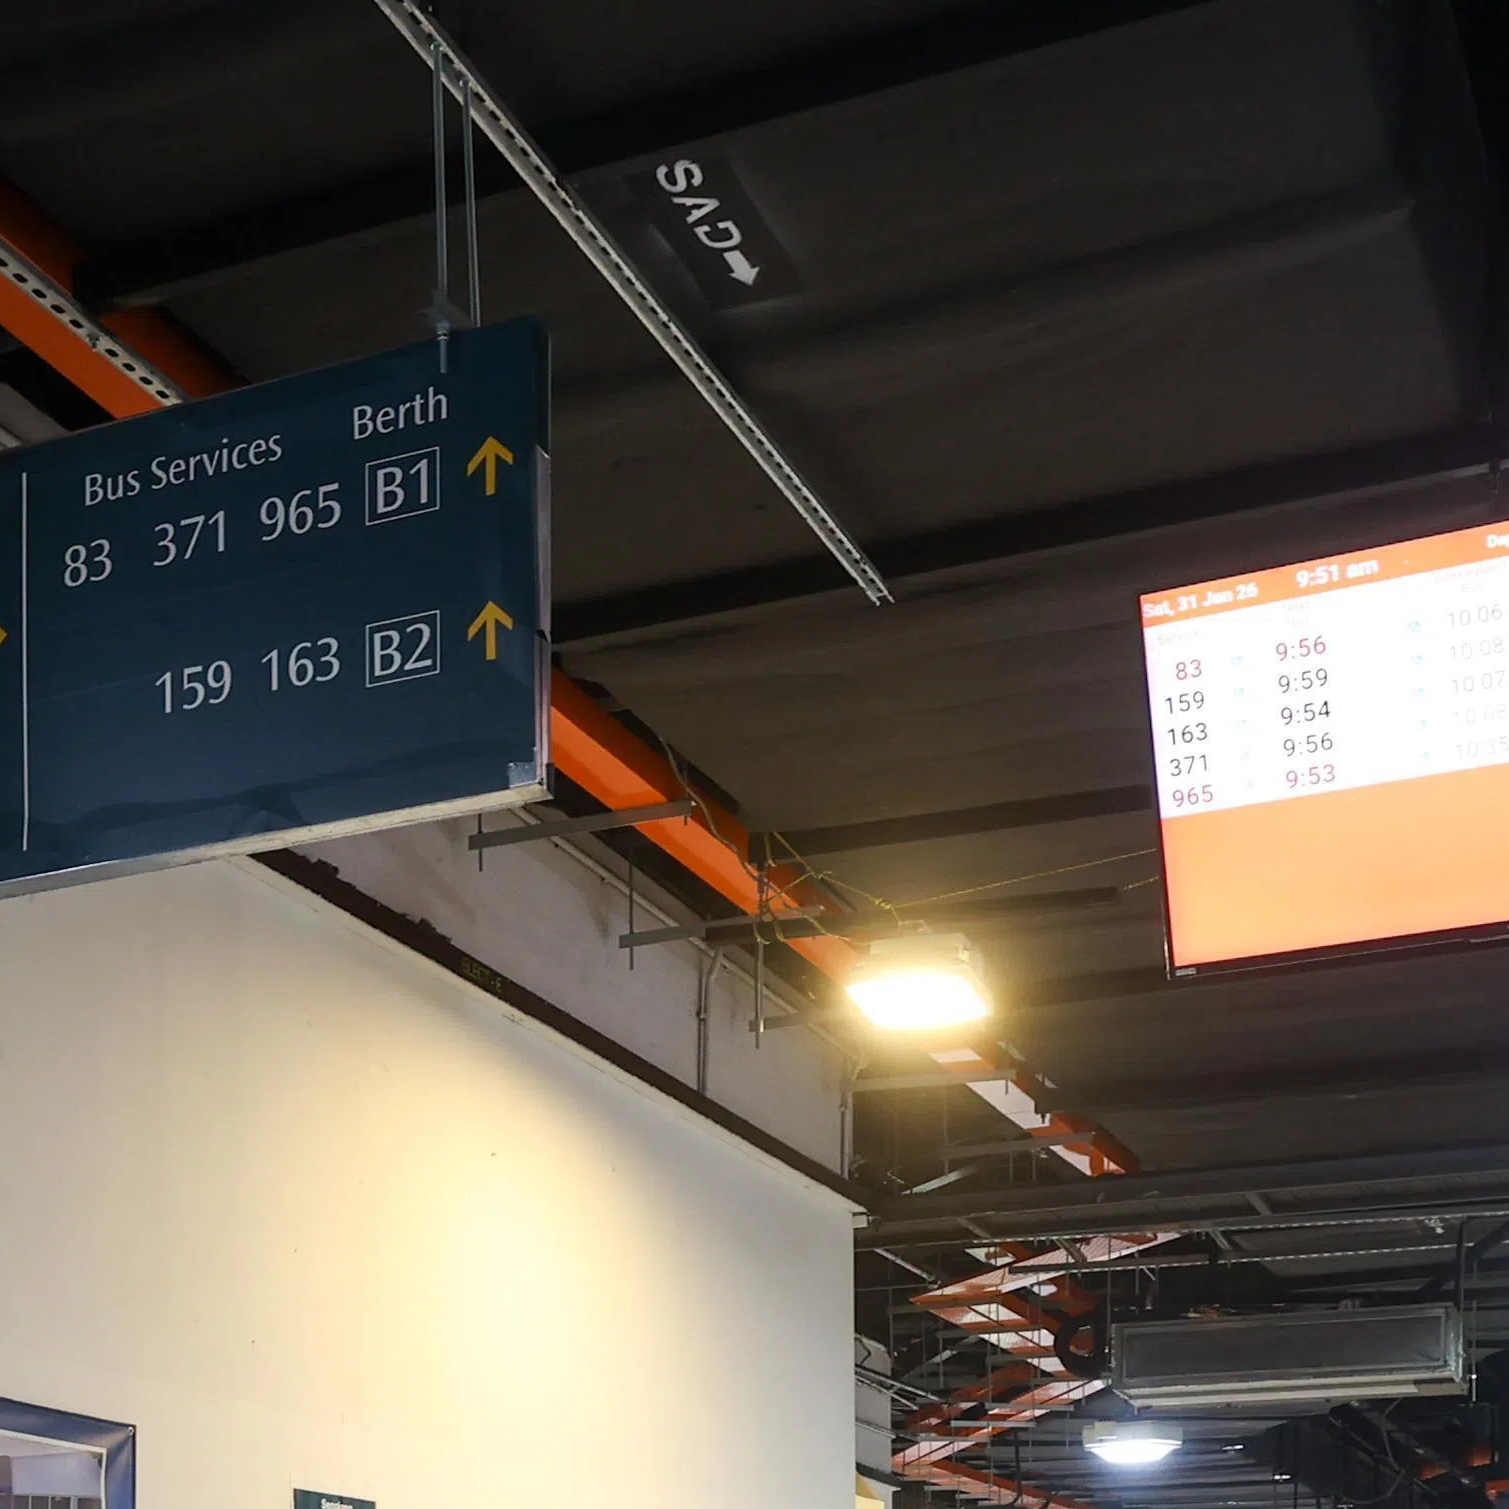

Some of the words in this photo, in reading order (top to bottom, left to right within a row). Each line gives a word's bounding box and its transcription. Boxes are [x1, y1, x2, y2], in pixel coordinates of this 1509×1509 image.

[84, 467, 141, 508] Bus
[149, 432, 283, 493] Services
[351, 386, 449, 442] Berth
[62, 537, 114, 590] 83
[153, 509, 229, 570] 371
[258, 485, 343, 544] 965
[374, 457, 433, 516] B1
[1296, 564, 1340, 588] 9:51
[1346, 558, 1379, 579] am
[1178, 595, 1197, 612] 31
[1202, 589, 1233, 607] Jan
[156, 662, 234, 716] 159
[261, 636, 342, 693] 163
[372, 621, 433, 677] B2
[1175, 659, 1202, 681] 83
[1275, 635, 1327, 662] 9:56
[1164, 690, 1206, 716] 159
[1278, 667, 1329, 695] 9:59
[1167, 721, 1209, 747] 163
[1280, 699, 1332, 726] 9:54
[1169, 754, 1210, 779] 371
[1283, 732, 1334, 757] 9:56
[1171, 783, 1214, 809] 965
[1285, 763, 1337, 790] 9:53
